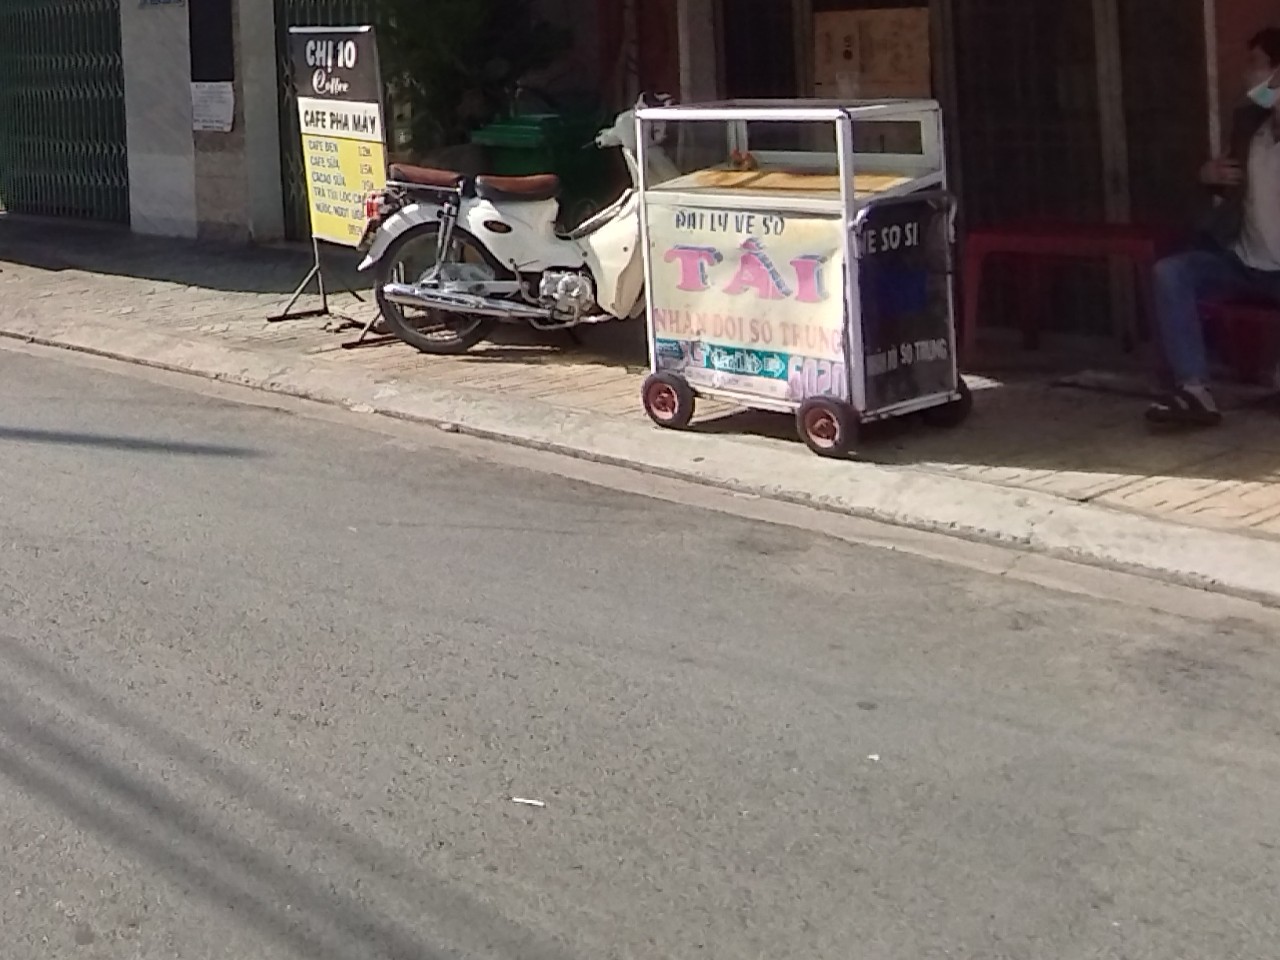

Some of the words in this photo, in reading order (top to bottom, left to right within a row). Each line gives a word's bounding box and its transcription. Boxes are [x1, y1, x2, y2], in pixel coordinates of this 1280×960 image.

[306, 40, 333, 73] CHỊ
[337, 40, 356, 68] 10
[304, 109, 326, 129] CAFE
[330, 111, 349, 131] PHA
[352, 110, 376, 134] MÁY
